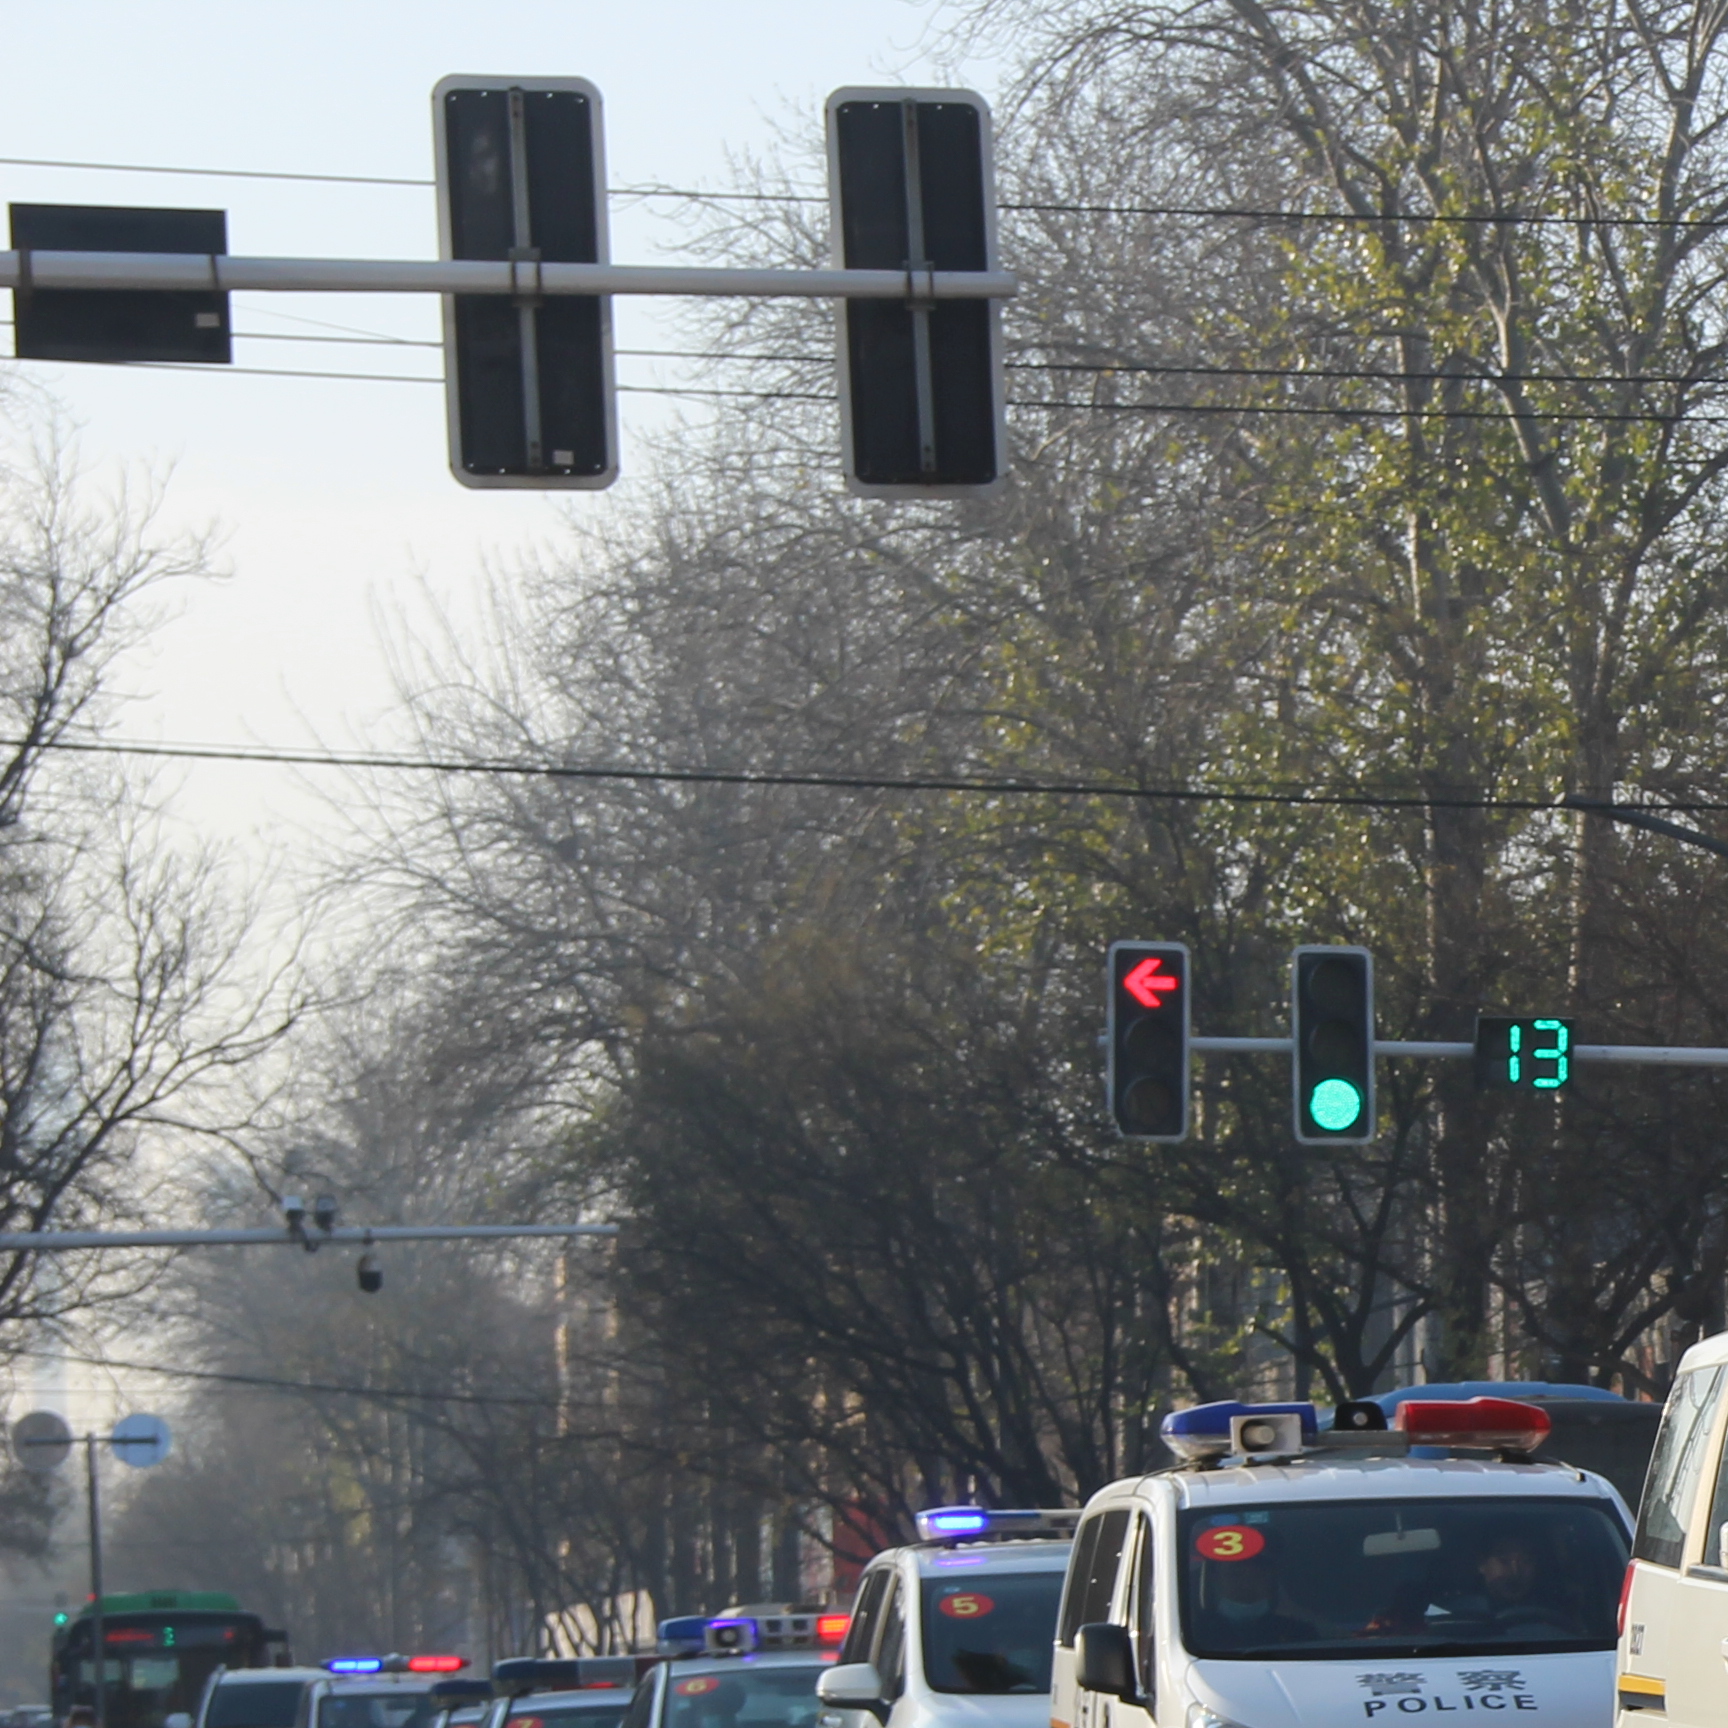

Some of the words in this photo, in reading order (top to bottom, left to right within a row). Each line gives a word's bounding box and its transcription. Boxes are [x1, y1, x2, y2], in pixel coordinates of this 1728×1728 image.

[1508, 1019, 1568, 1089] 13
[1213, 1531, 1244, 1555] 3
[952, 1596, 979, 1615] 5
[1355, 1669, 1527, 1697] 警察
[1363, 1694, 1540, 1719] POLICE
